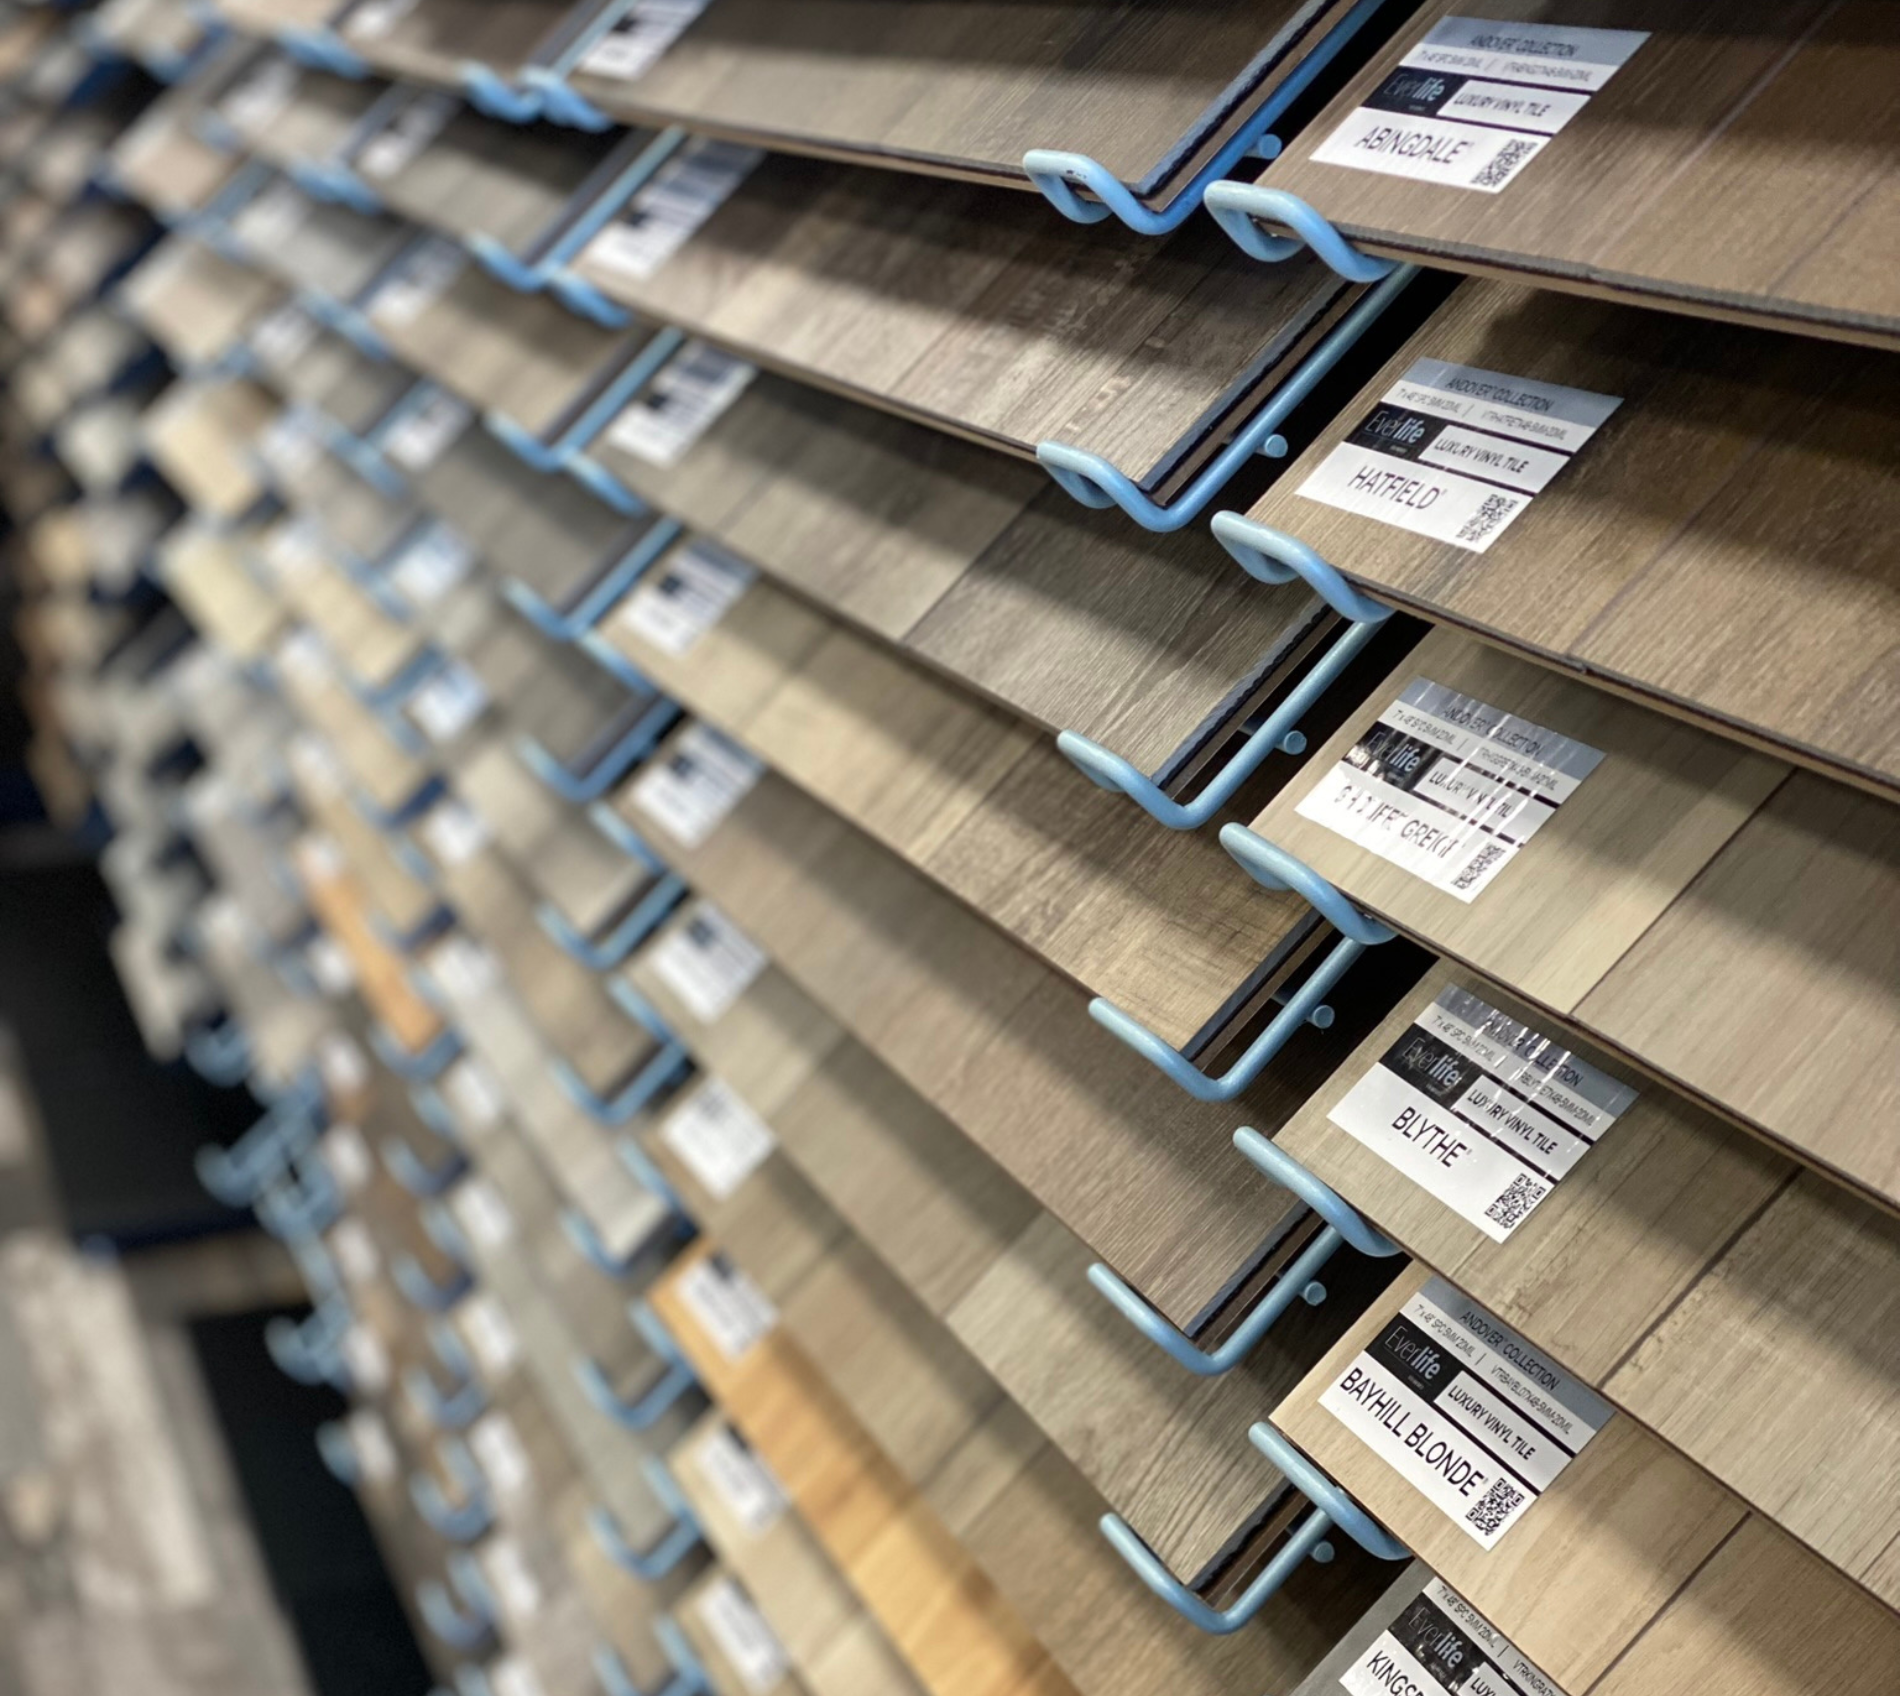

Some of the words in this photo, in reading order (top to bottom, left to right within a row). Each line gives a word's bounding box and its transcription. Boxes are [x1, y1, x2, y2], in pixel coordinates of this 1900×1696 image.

[1383, 74, 1445, 102] Everlife
[1453, 94, 1494, 107] LUXURY
[1521, 101, 1552, 118] TILE
[1355, 125, 1469, 164] ABINGDALE
[1364, 410, 1425, 444] Everlife
[1433, 438, 1474, 457] LUXURY
[1473, 449, 1503, 467] VINYL
[1506, 456, 1529, 473] TILE
[1347, 465, 1440, 509] HATFIELD
[1401, 1037, 1460, 1088] Everlife
[1391, 1105, 1467, 1167] BLYTHE
[1504, 1115, 1534, 1141] VINYL
[1532, 1131, 1558, 1155] TILE
[1384, 1325, 1440, 1380] Everlife
[1459, 1310, 1506, 1347] ANDOVER
[1502, 1343, 1560, 1391] COLLECTION
[1339, 1366, 1410, 1437] BAYHILL
[1403, 1422, 1484, 1497] BLONDE
[1447, 1384, 1489, 1419] LUXURY
[1483, 1413, 1513, 1443] VINYL
[1510, 1435, 1535, 1460] TILE
[1407, 1606, 1463, 1669] Everlife
